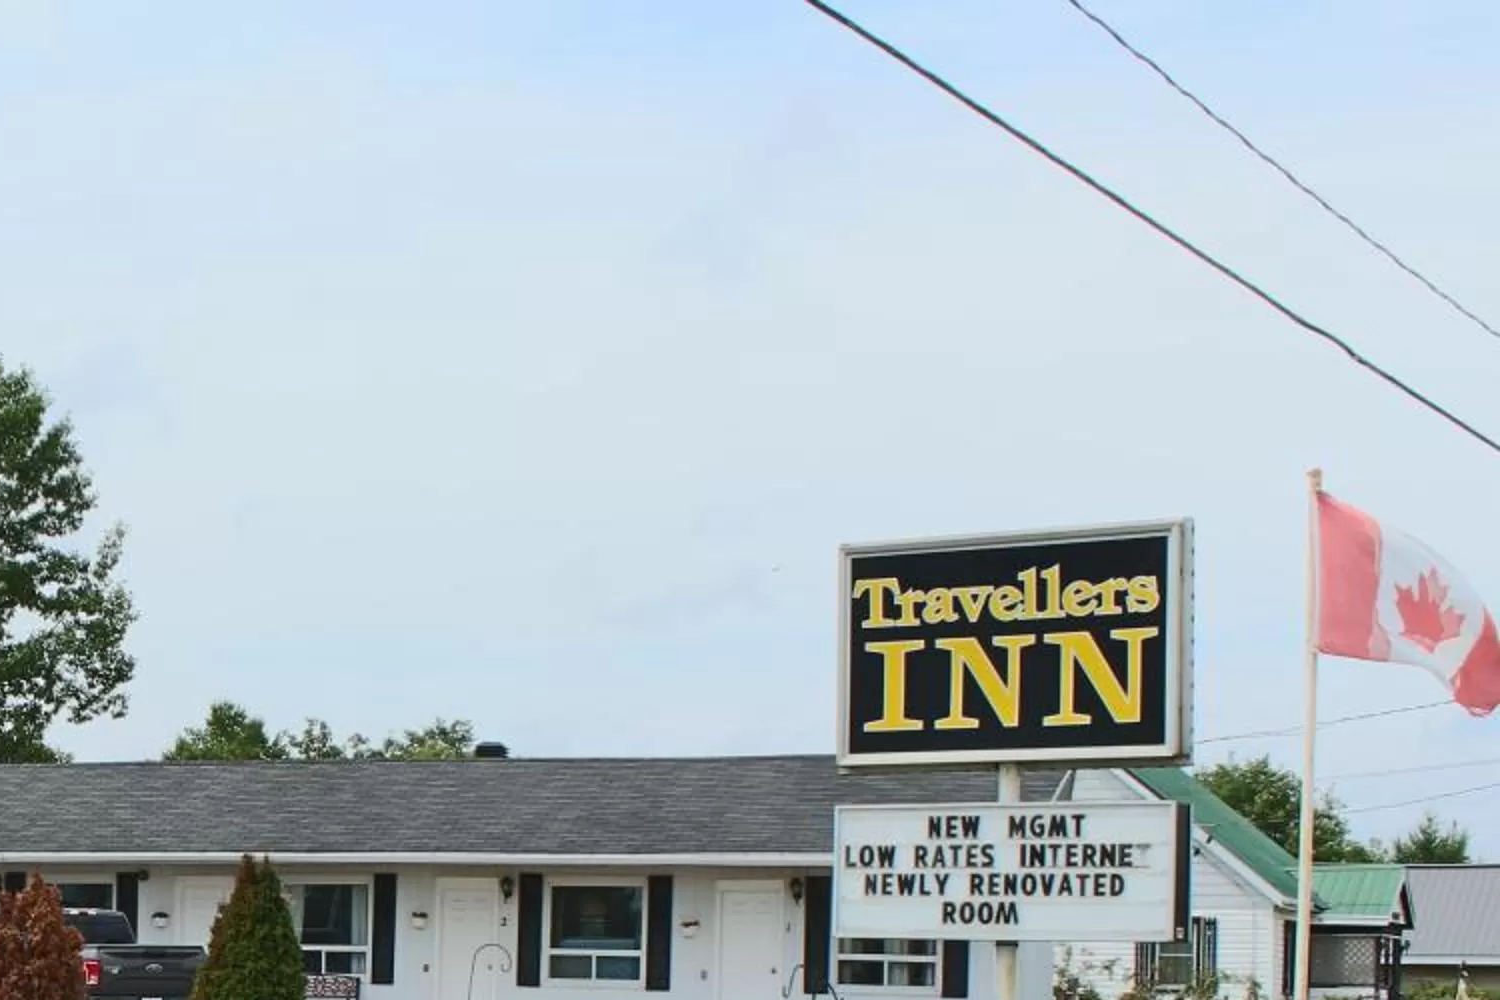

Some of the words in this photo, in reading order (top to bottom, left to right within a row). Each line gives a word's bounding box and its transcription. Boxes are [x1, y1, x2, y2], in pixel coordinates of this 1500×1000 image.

[852, 563, 1160, 629] Travellers
[863, 627, 1160, 732] INN
[928, 815, 980, 839] NEW
[1008, 814, 1086, 838] MGMT
[845, 845, 896, 868] LOW
[914, 843, 995, 868] RATES
[864, 873, 949, 896] NEWLY
[970, 872, 1125, 896] RENOVATED
[942, 901, 1019, 925] ROOM
